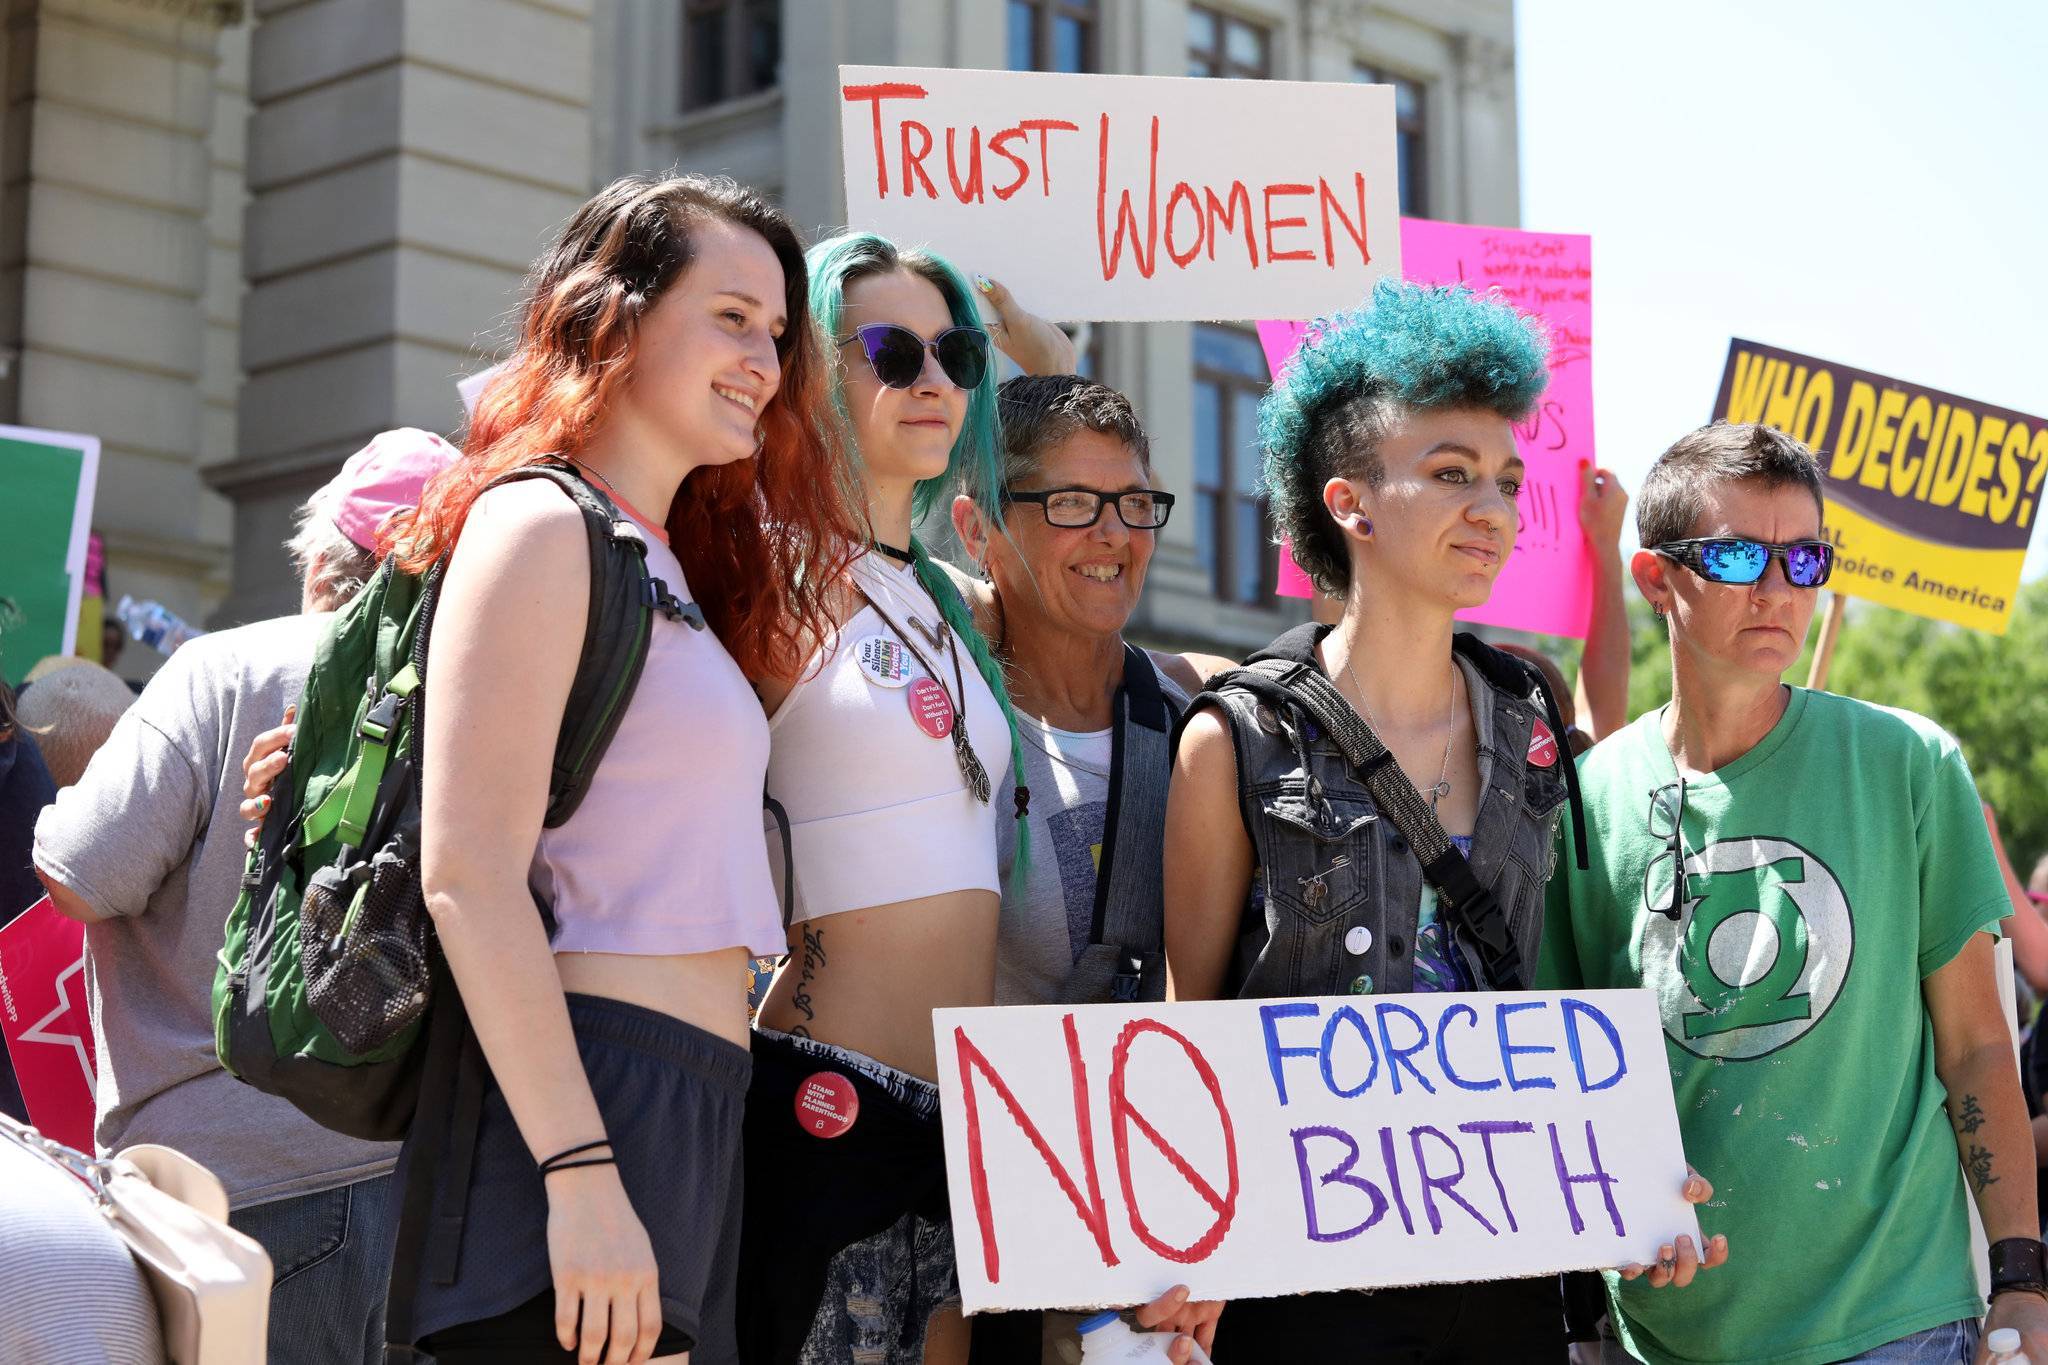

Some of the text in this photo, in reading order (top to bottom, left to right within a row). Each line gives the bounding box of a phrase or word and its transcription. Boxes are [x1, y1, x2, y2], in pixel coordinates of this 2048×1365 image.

[843, 82, 1371, 282] TRUST WOMEN
[1727, 350, 2048, 528] WHO DECIDES?
[1904, 571, 2010, 613] America
[862, 643, 871, 663] Your
[872, 639, 881, 672] Silence
[880, 640, 891, 677] Will Not
[890, 642, 901, 679] Protect
[1258, 997, 1628, 1106] FORCED
[803, 1095, 836, 1111] PLANNED
[806, 1088, 826, 1100] WITH
[811, 1083, 836, 1097] STAND
[801, 1101, 849, 1123] PARENTHOOD
[952, 1012, 1240, 1285] NO
[1289, 1119, 1627, 1243] BIRTH
